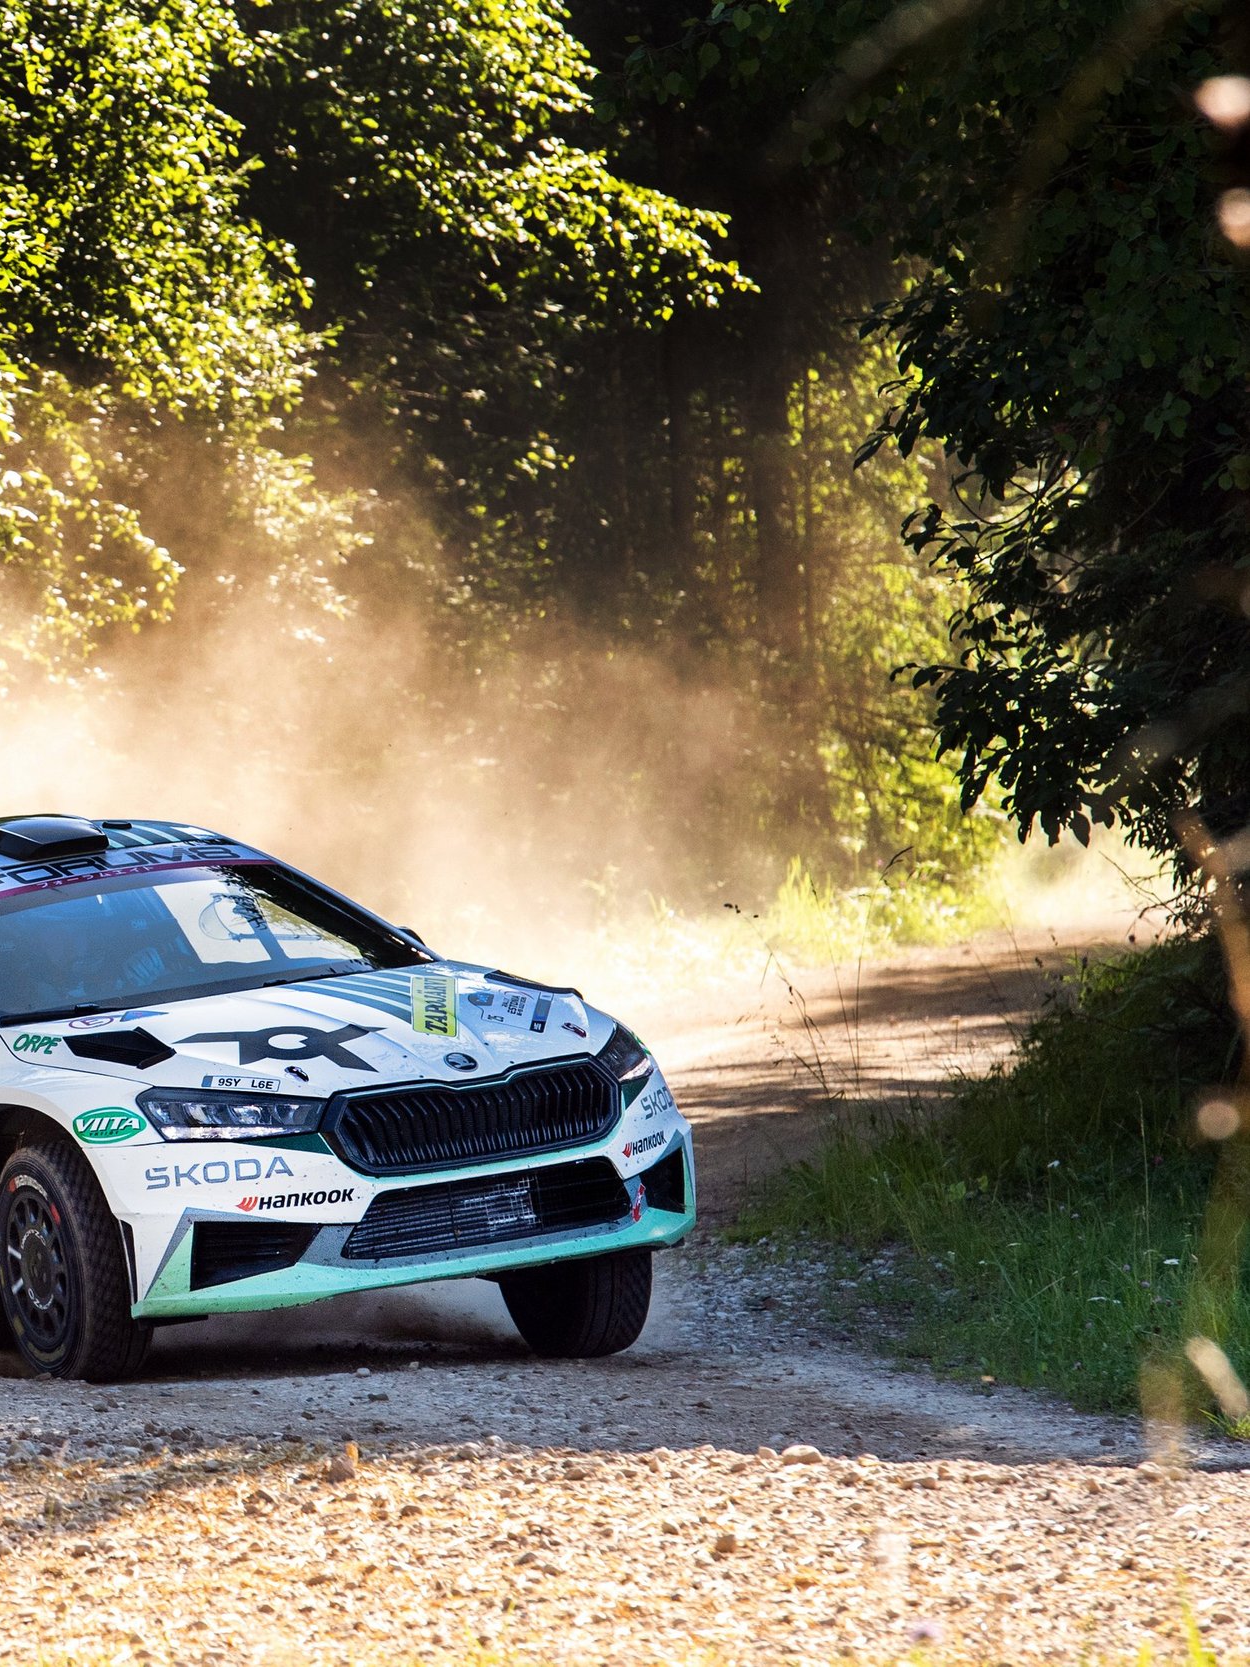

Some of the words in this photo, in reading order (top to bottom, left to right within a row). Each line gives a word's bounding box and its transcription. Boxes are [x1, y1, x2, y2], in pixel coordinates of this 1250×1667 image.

[12, 1033, 63, 1055] ORPE
[217, 1077, 241, 1087] 9SY
[250, 1079, 275, 1090] L6E
[75, 1116, 141, 1133] VIITA
